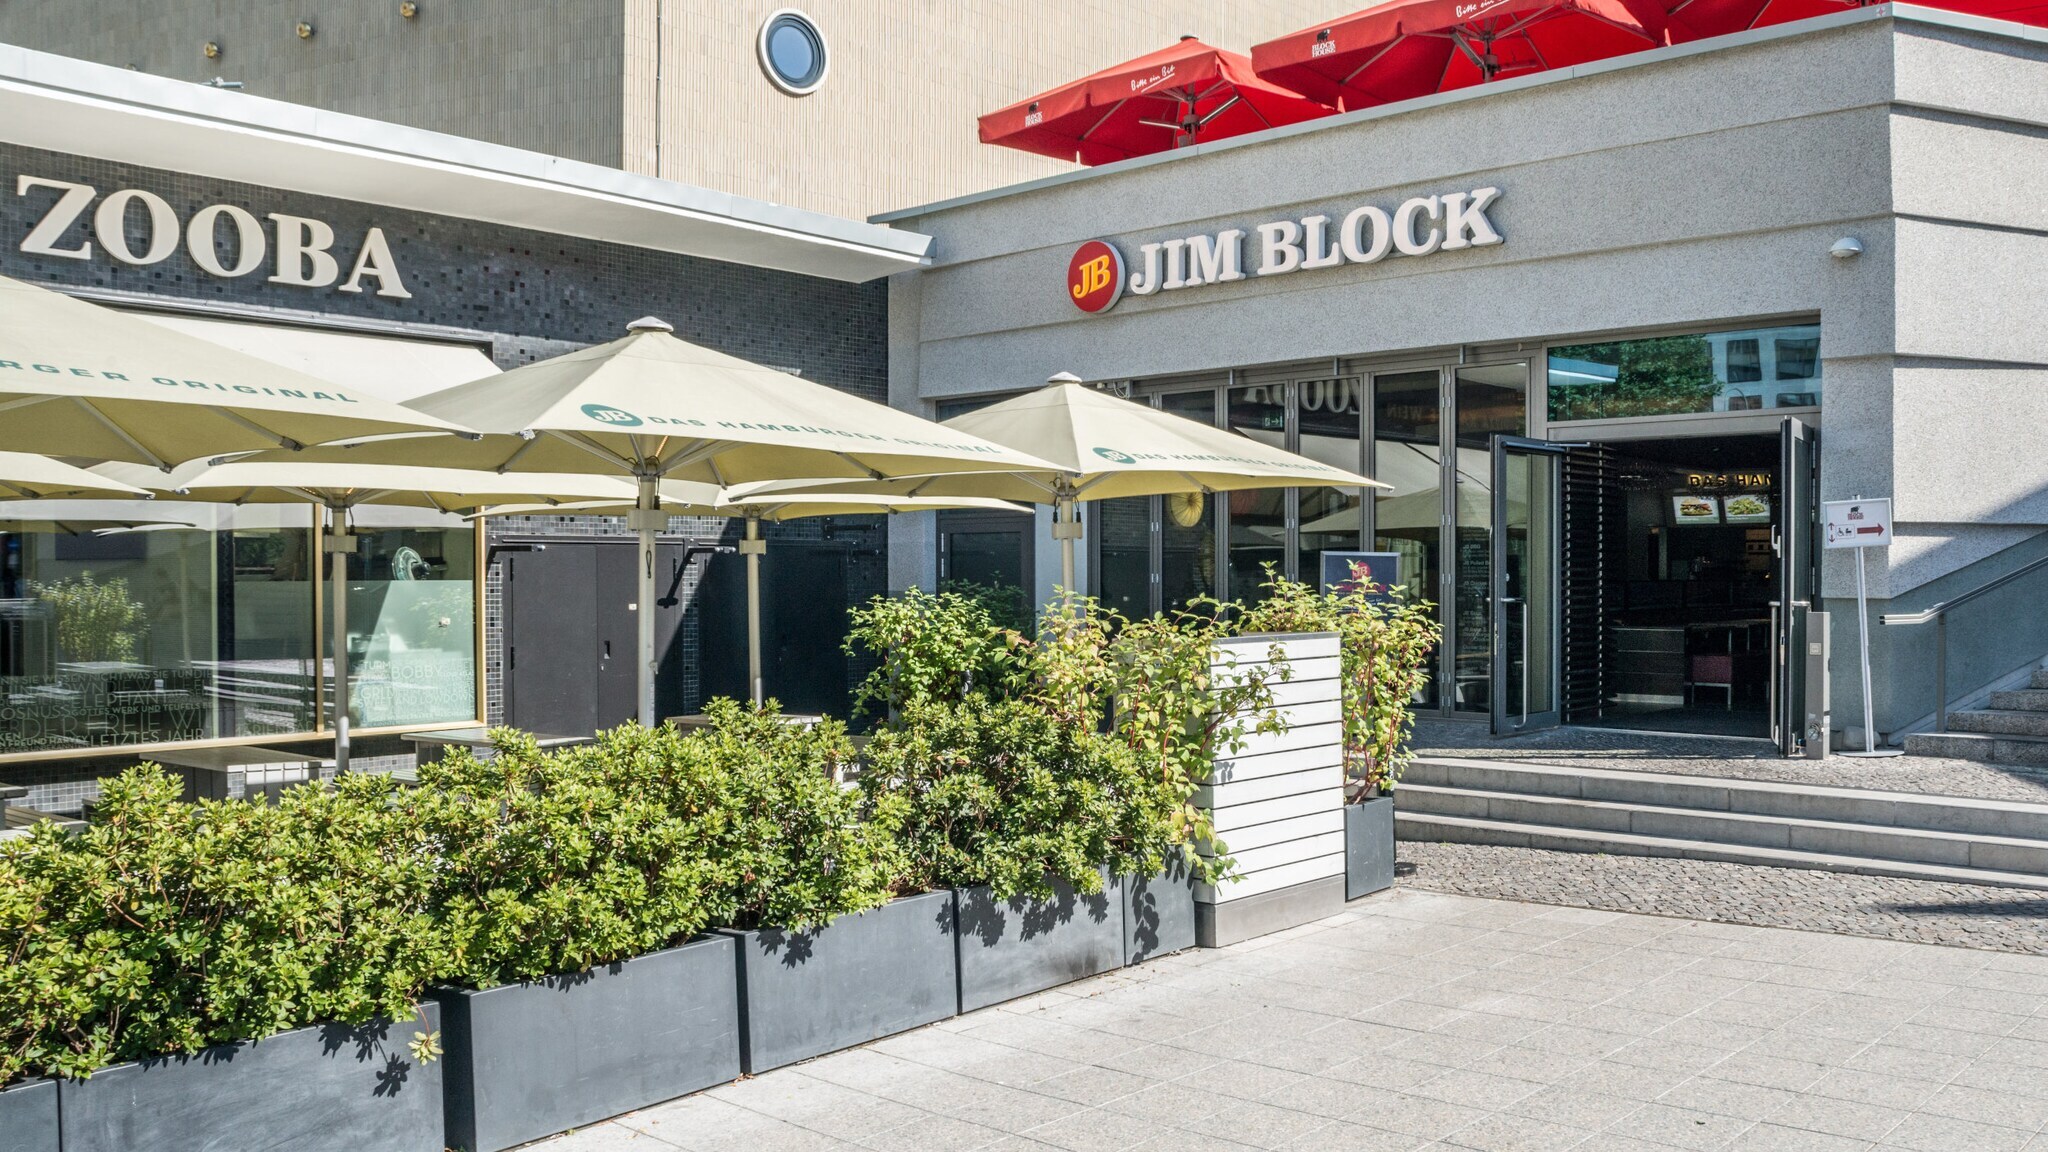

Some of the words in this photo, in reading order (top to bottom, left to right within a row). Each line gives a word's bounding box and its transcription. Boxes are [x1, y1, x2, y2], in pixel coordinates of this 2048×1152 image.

[16, 174, 412, 298] ZOOBA
[1073, 254, 1110, 299] JB
[1130, 229, 1246, 296] JIM
[1257, 186, 1503, 276] BLOCK
[152, 376, 358, 403] ORIGINAL
[593, 410, 633, 422] JB
[648, 416, 706, 427] DAS
[716, 421, 886, 441] HAMBURGER
[894, 438, 1001, 454] ORIGINAL
[1689, 474, 1727, 487] DAS
[112, 706, 139, 714] WERK
[164, 729, 205, 743] JAHR
